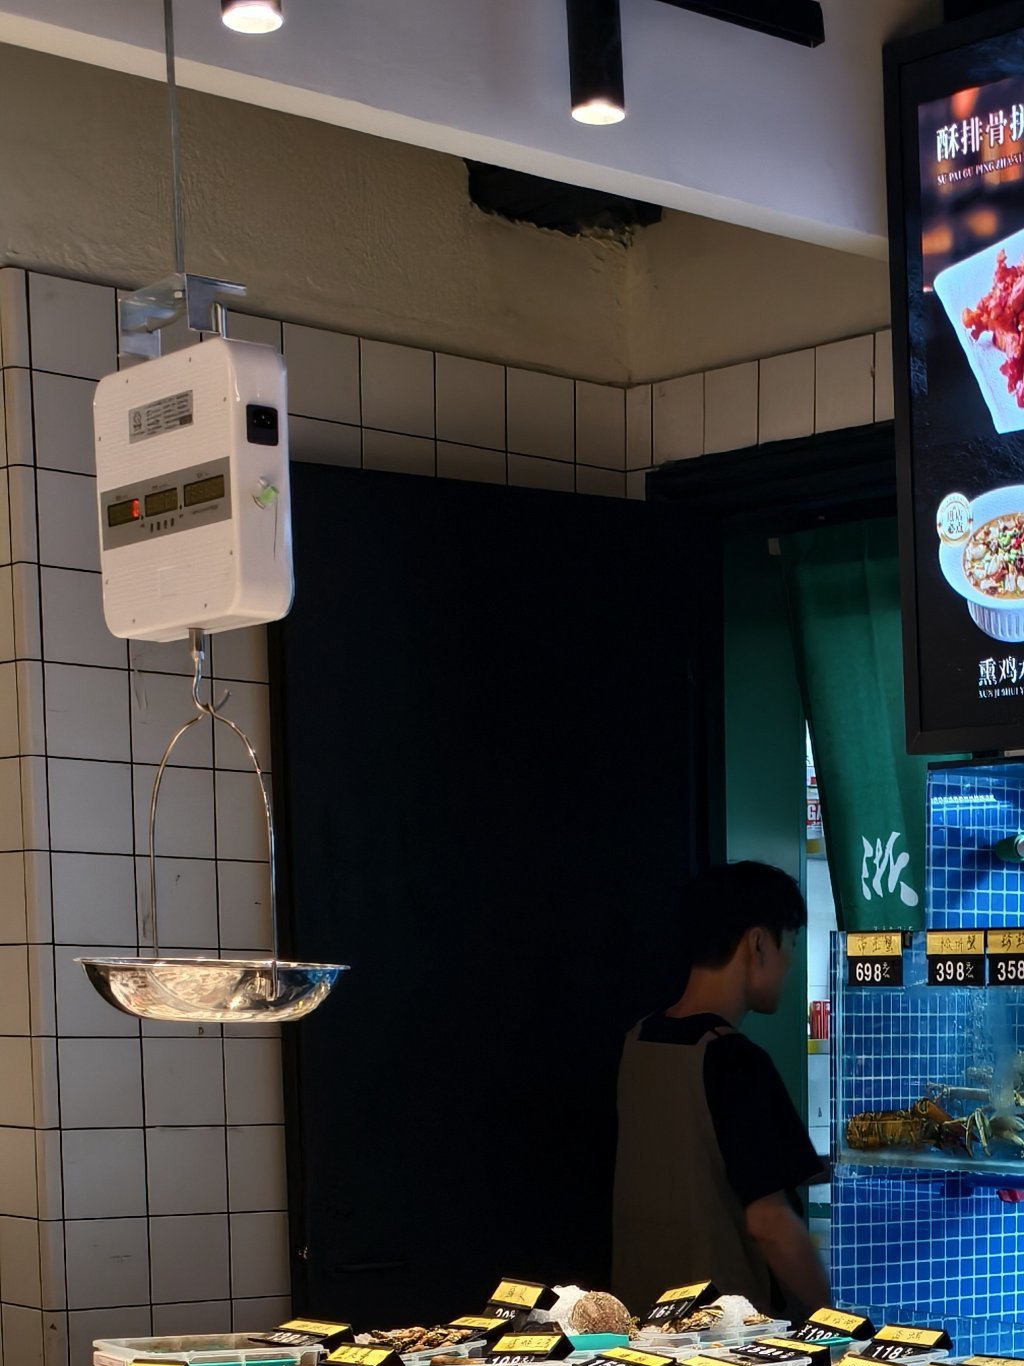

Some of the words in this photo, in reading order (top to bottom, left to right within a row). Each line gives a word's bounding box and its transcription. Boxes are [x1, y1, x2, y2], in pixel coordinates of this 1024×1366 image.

[855, 962, 882, 982] 698
[936, 961, 965, 982] 398
[872, 1346, 903, 1359] 118
